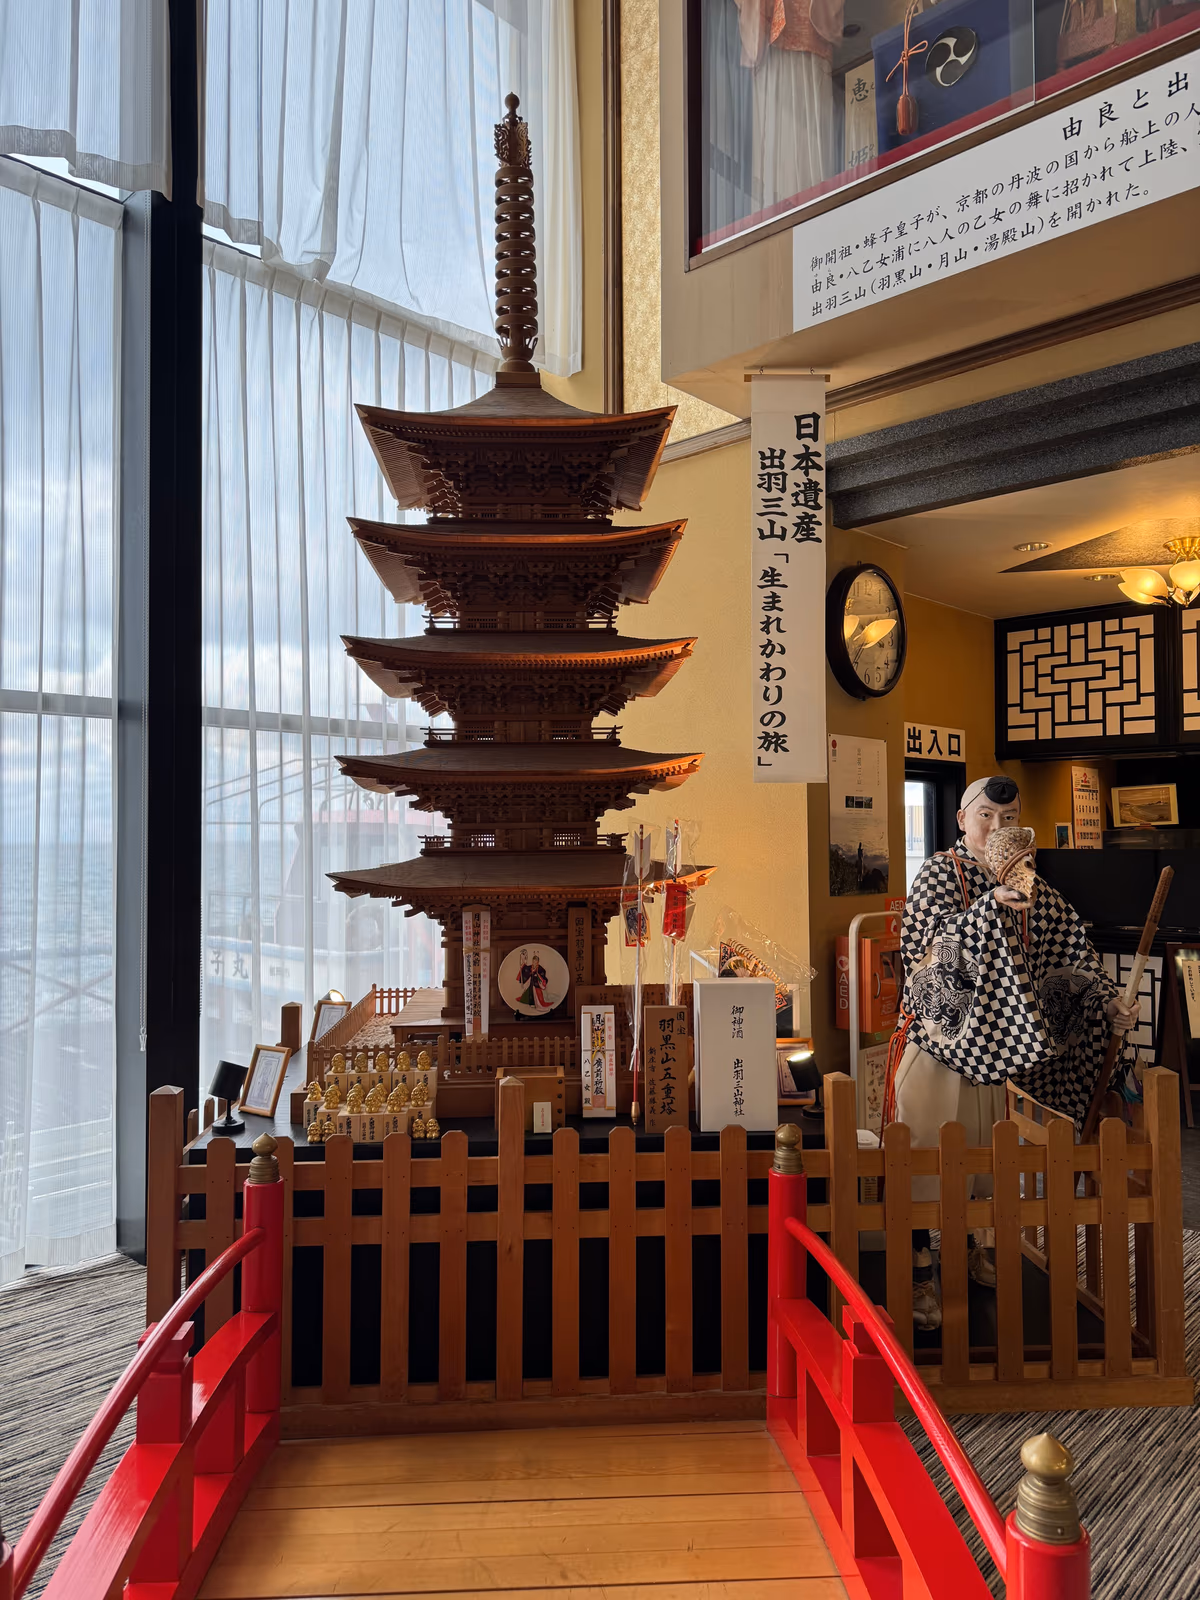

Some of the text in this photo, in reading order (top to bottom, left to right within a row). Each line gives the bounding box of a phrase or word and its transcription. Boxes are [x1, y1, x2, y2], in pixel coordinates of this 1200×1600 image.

[1062, 71, 1189, 140] 由良と出
[811, 122, 1200, 294] 由良・八乙女浦に八人の乙女の舞に招かれて上陸、
[791, 411, 823, 543] 日本遺産
[757, 447, 789, 767] 出羽三山「生まれかわりの旅」
[888, 632, 894, 647] 3
[864, 668, 870, 684] 6
[884, 652, 889, 669] 4
[907, 726, 962, 758] 出入口
[890, 900, 904, 911] AED
[838, 972, 849, 1010] AED
[730, 1005, 745, 1039] 御神酒
[658, 1017, 677, 1115] 羽黒山五重塔
[732, 1058, 746, 1117] 出羽三山神社
